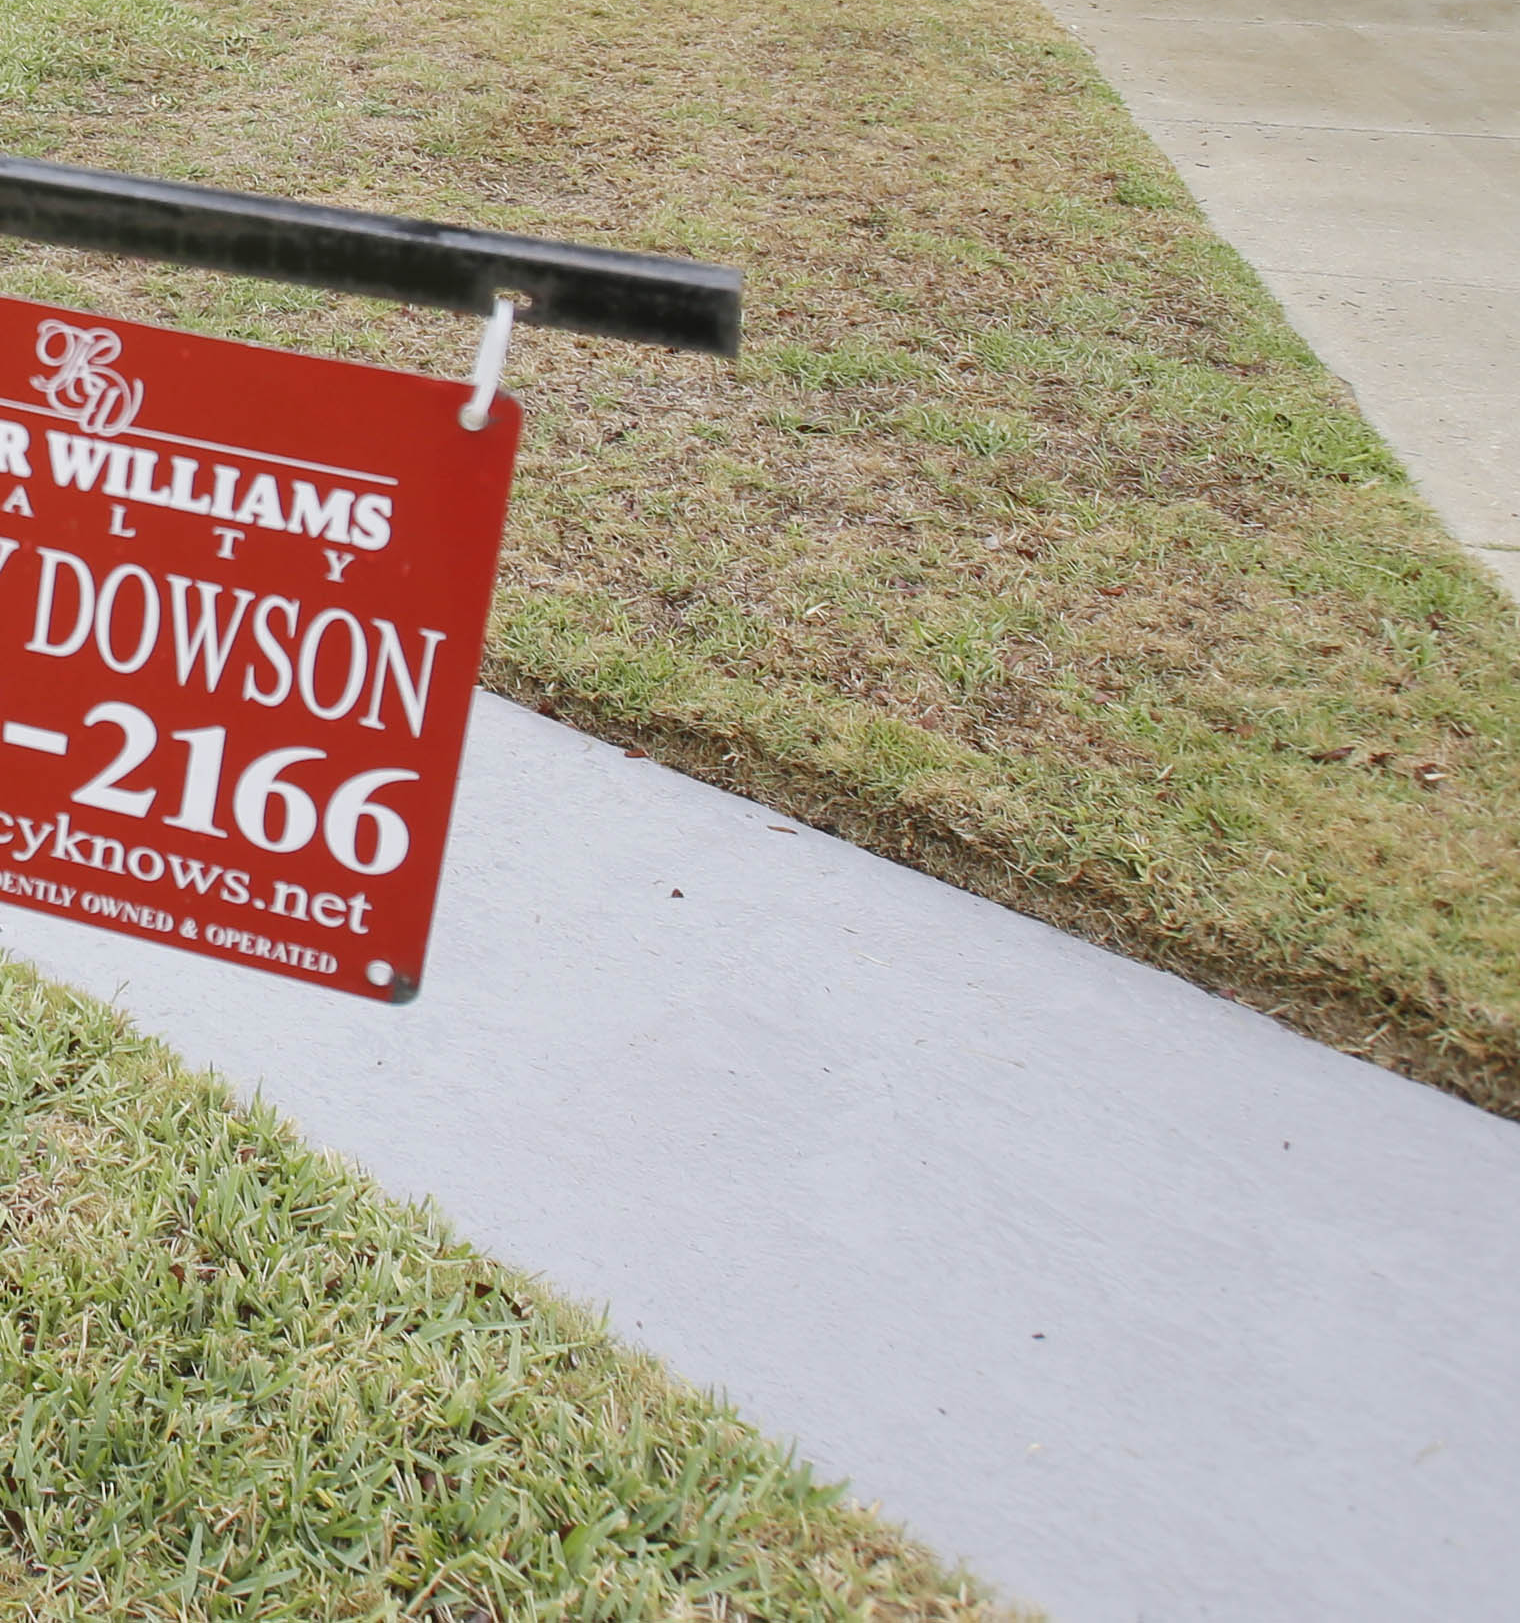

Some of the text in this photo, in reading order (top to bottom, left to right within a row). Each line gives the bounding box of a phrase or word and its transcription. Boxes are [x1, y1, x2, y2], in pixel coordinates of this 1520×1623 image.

[45, 429, 393, 551] WILLIAMS
[24, 546, 447, 738] DOWSON
[80, 891, 174, 933] OWNED
[179, 917, 199, 940] &
[205, 923, 338, 975] OPERATED
